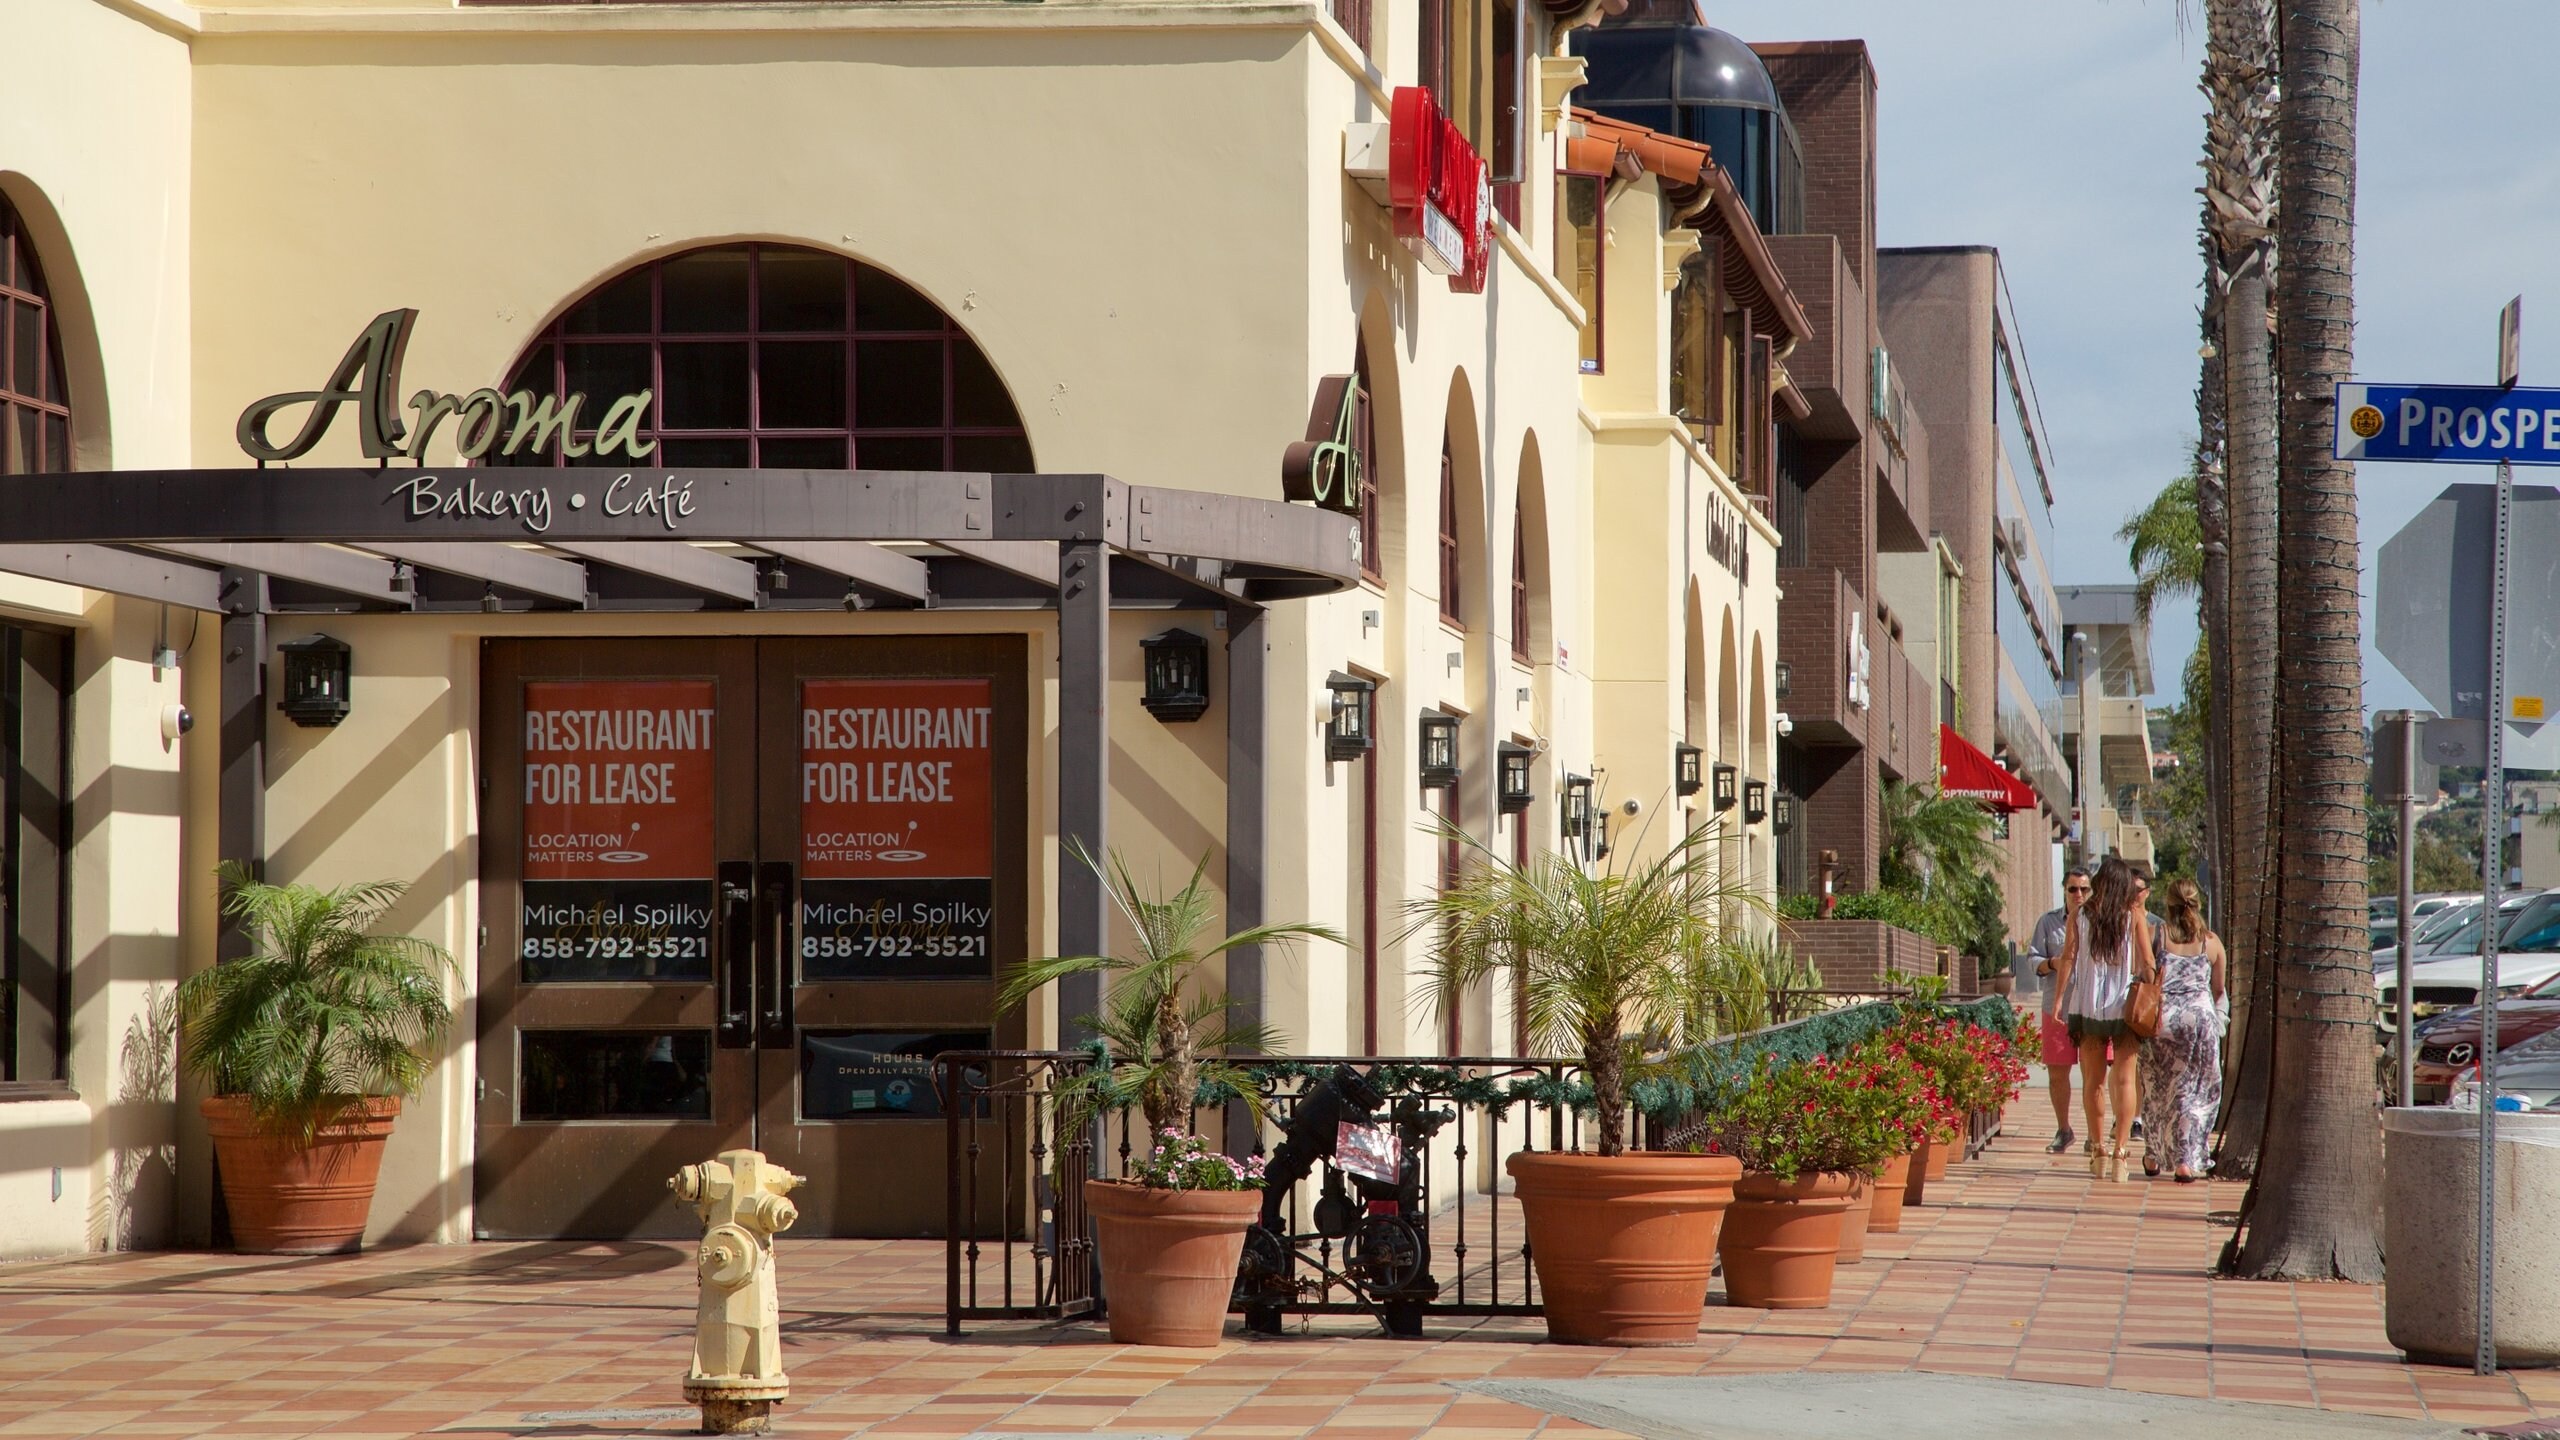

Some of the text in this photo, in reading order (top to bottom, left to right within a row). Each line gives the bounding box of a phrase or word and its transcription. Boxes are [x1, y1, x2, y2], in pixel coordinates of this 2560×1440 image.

[236, 307, 657, 460] Aroma
[392, 473, 696, 532] Bakery Café
[526, 709, 715, 751] RESTAURANT
[804, 707, 992, 750] RESTAURANT
[526, 763, 677, 805] FOR LEASE
[803, 761, 953, 803] FOR LEASE
[1942, 788, 2006, 800] OPTOMETRY
[528, 834, 622, 848] LOCATION
[807, 832, 899, 847] LOCATION
[528, 851, 594, 863] MATTERS
[807, 850, 872, 862] MATTERS
[524, 903, 713, 930] Michael Spilky
[803, 902, 991, 929] Michael Spilky
[523, 936, 707, 959] 858-792-5521
[801, 935, 986, 958] 858-792-5521
[872, 1053, 924, 1063] HOURS
